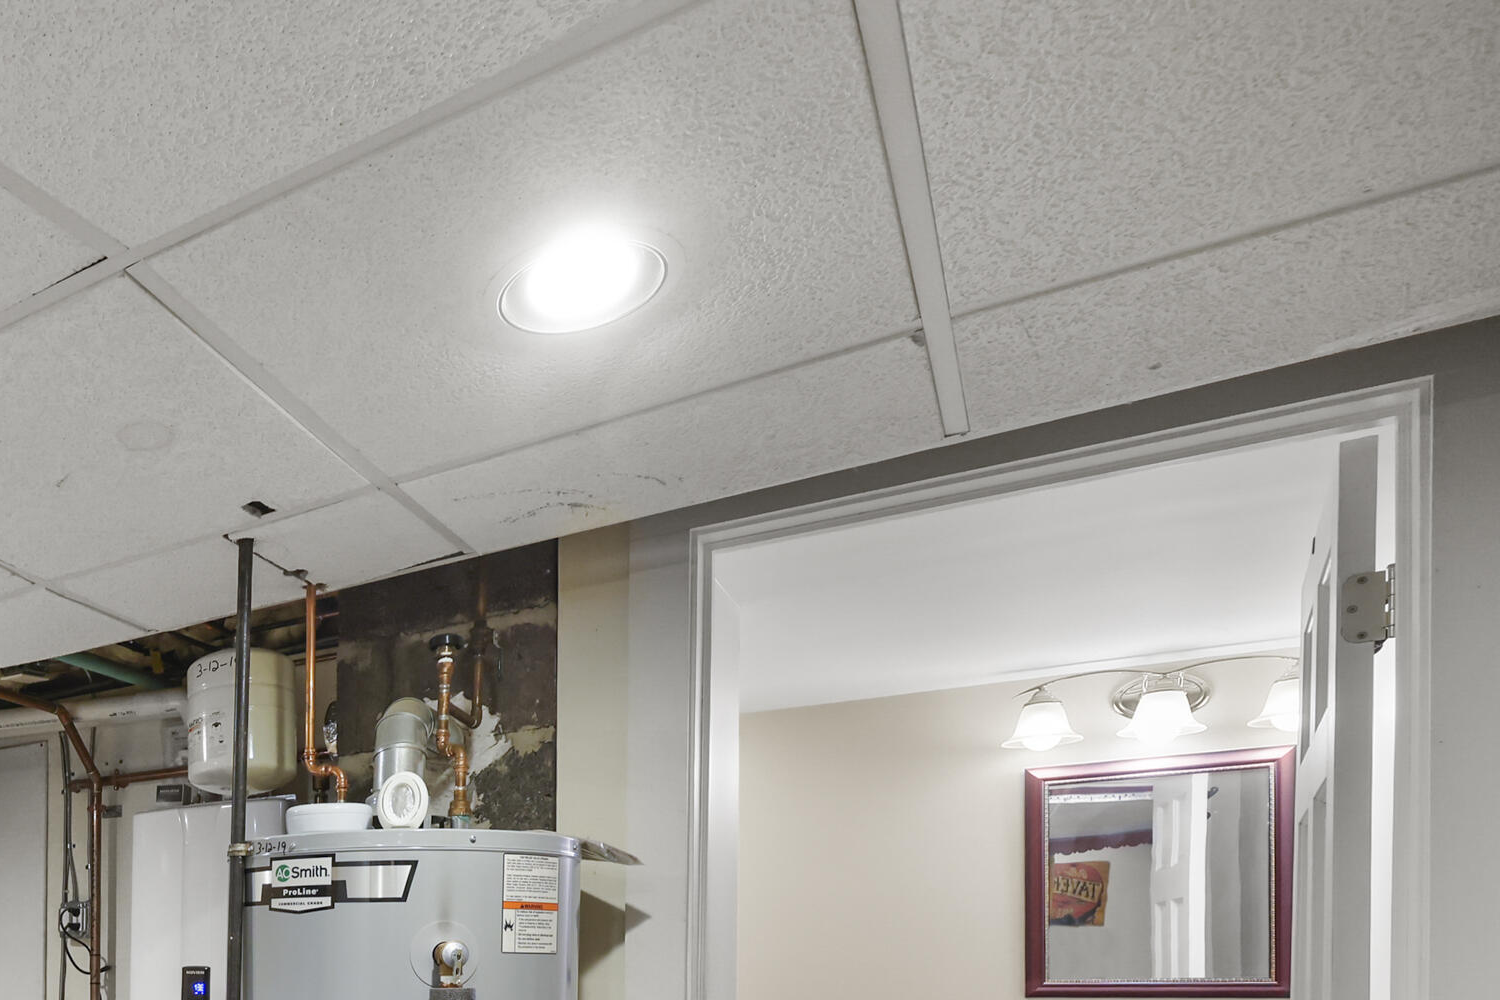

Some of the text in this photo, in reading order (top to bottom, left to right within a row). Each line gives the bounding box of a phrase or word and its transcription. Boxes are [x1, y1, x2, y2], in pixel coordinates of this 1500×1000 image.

[196, 656, 237, 678] 3-12-1
[256, 841, 287, 855] 3-12-19
[283, 887, 317, 897] ProLine
